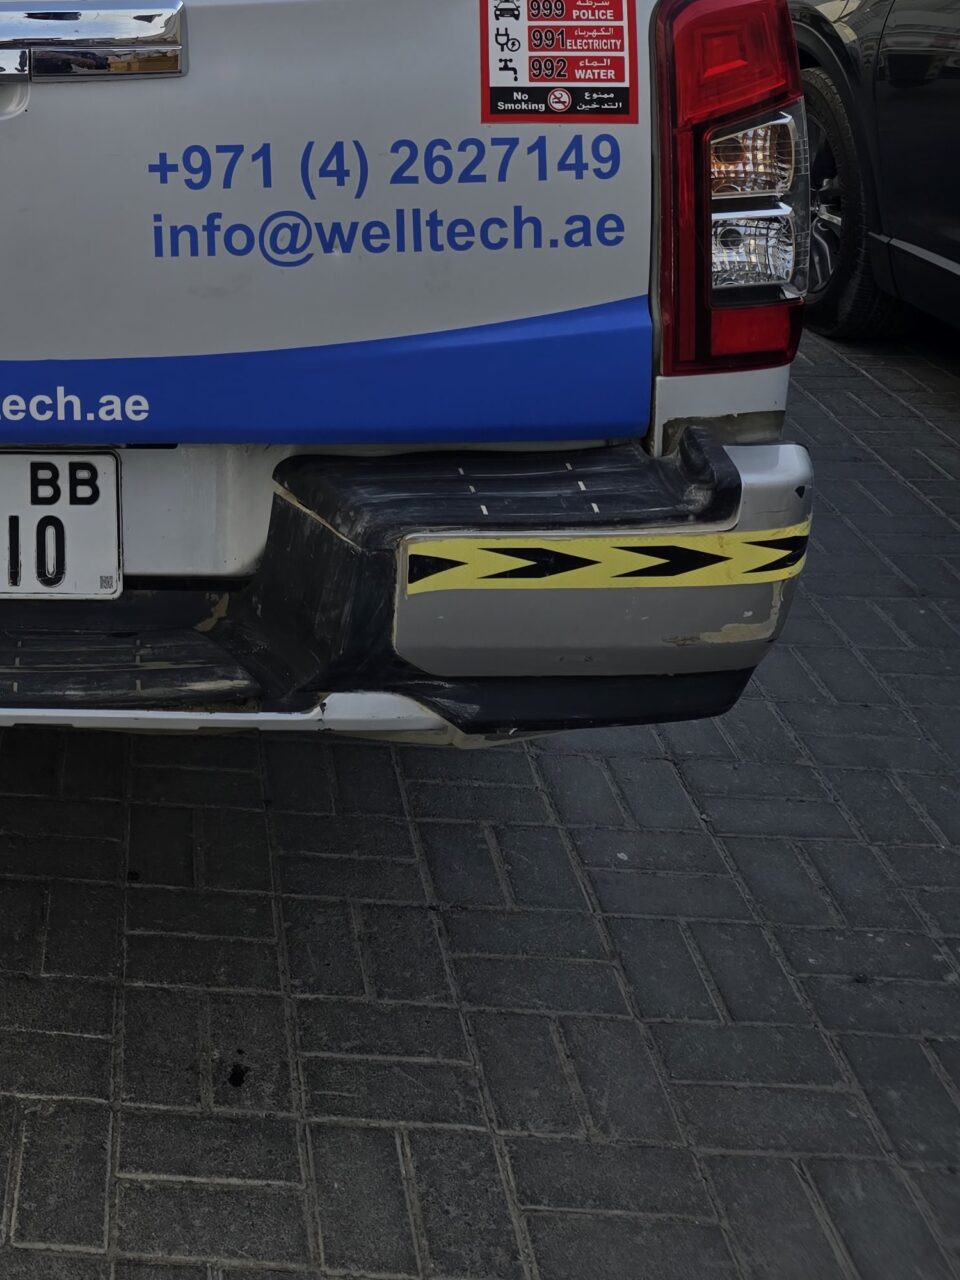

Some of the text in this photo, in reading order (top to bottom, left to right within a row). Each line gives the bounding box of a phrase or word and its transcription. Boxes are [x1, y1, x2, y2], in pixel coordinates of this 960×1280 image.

[529, 0, 565, 18] 999
[572, 9, 614, 20] POLICE
[574, 27, 614, 37] الكهرباء
[532, 28, 566, 49] 991
[566, 38, 622, 50] ELECTRICITY
[531, 58, 568, 78] 992
[579, 58, 611, 67] الماء
[575, 69, 616, 80] WATER
[513, 92, 529, 101] No
[584, 91, 615, 99] ممنوع
[497, 101, 546, 112] Smoking
[576, 100, 622, 110] التدخين
[147, 133, 622, 200] +971 (4) 2627149
[152, 204, 626, 269] info@welltech.ae
[29, 461, 101, 506] BB
